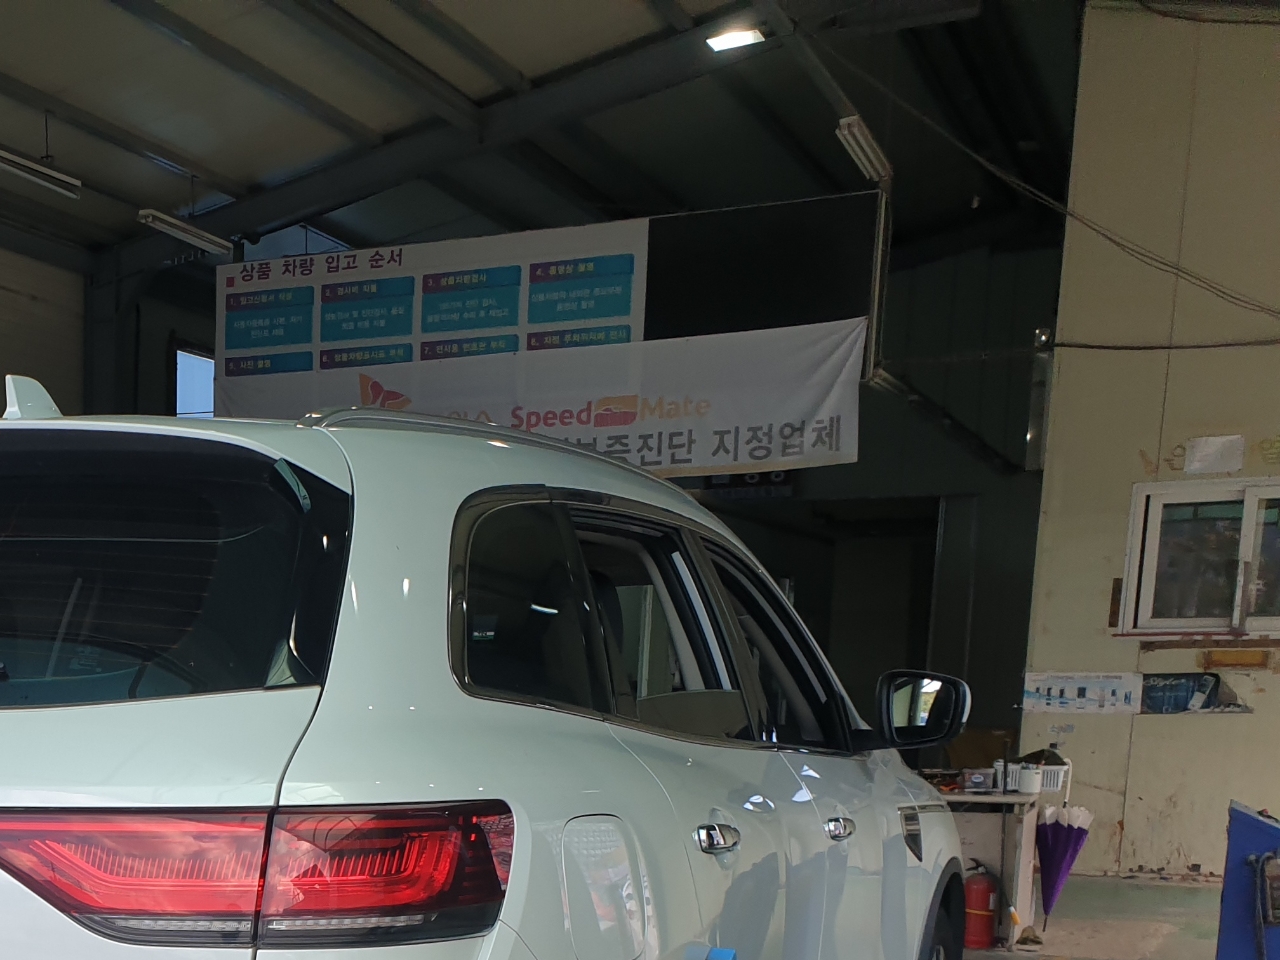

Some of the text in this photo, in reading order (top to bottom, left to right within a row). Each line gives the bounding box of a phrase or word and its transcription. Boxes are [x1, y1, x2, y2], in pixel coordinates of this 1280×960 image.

[240, 248, 404, 282] 상품 차량 입고 순서
[510, 401, 592, 432] Speed
[639, 395, 711, 421] Mate
[711, 415, 842, 462] 지정업체
